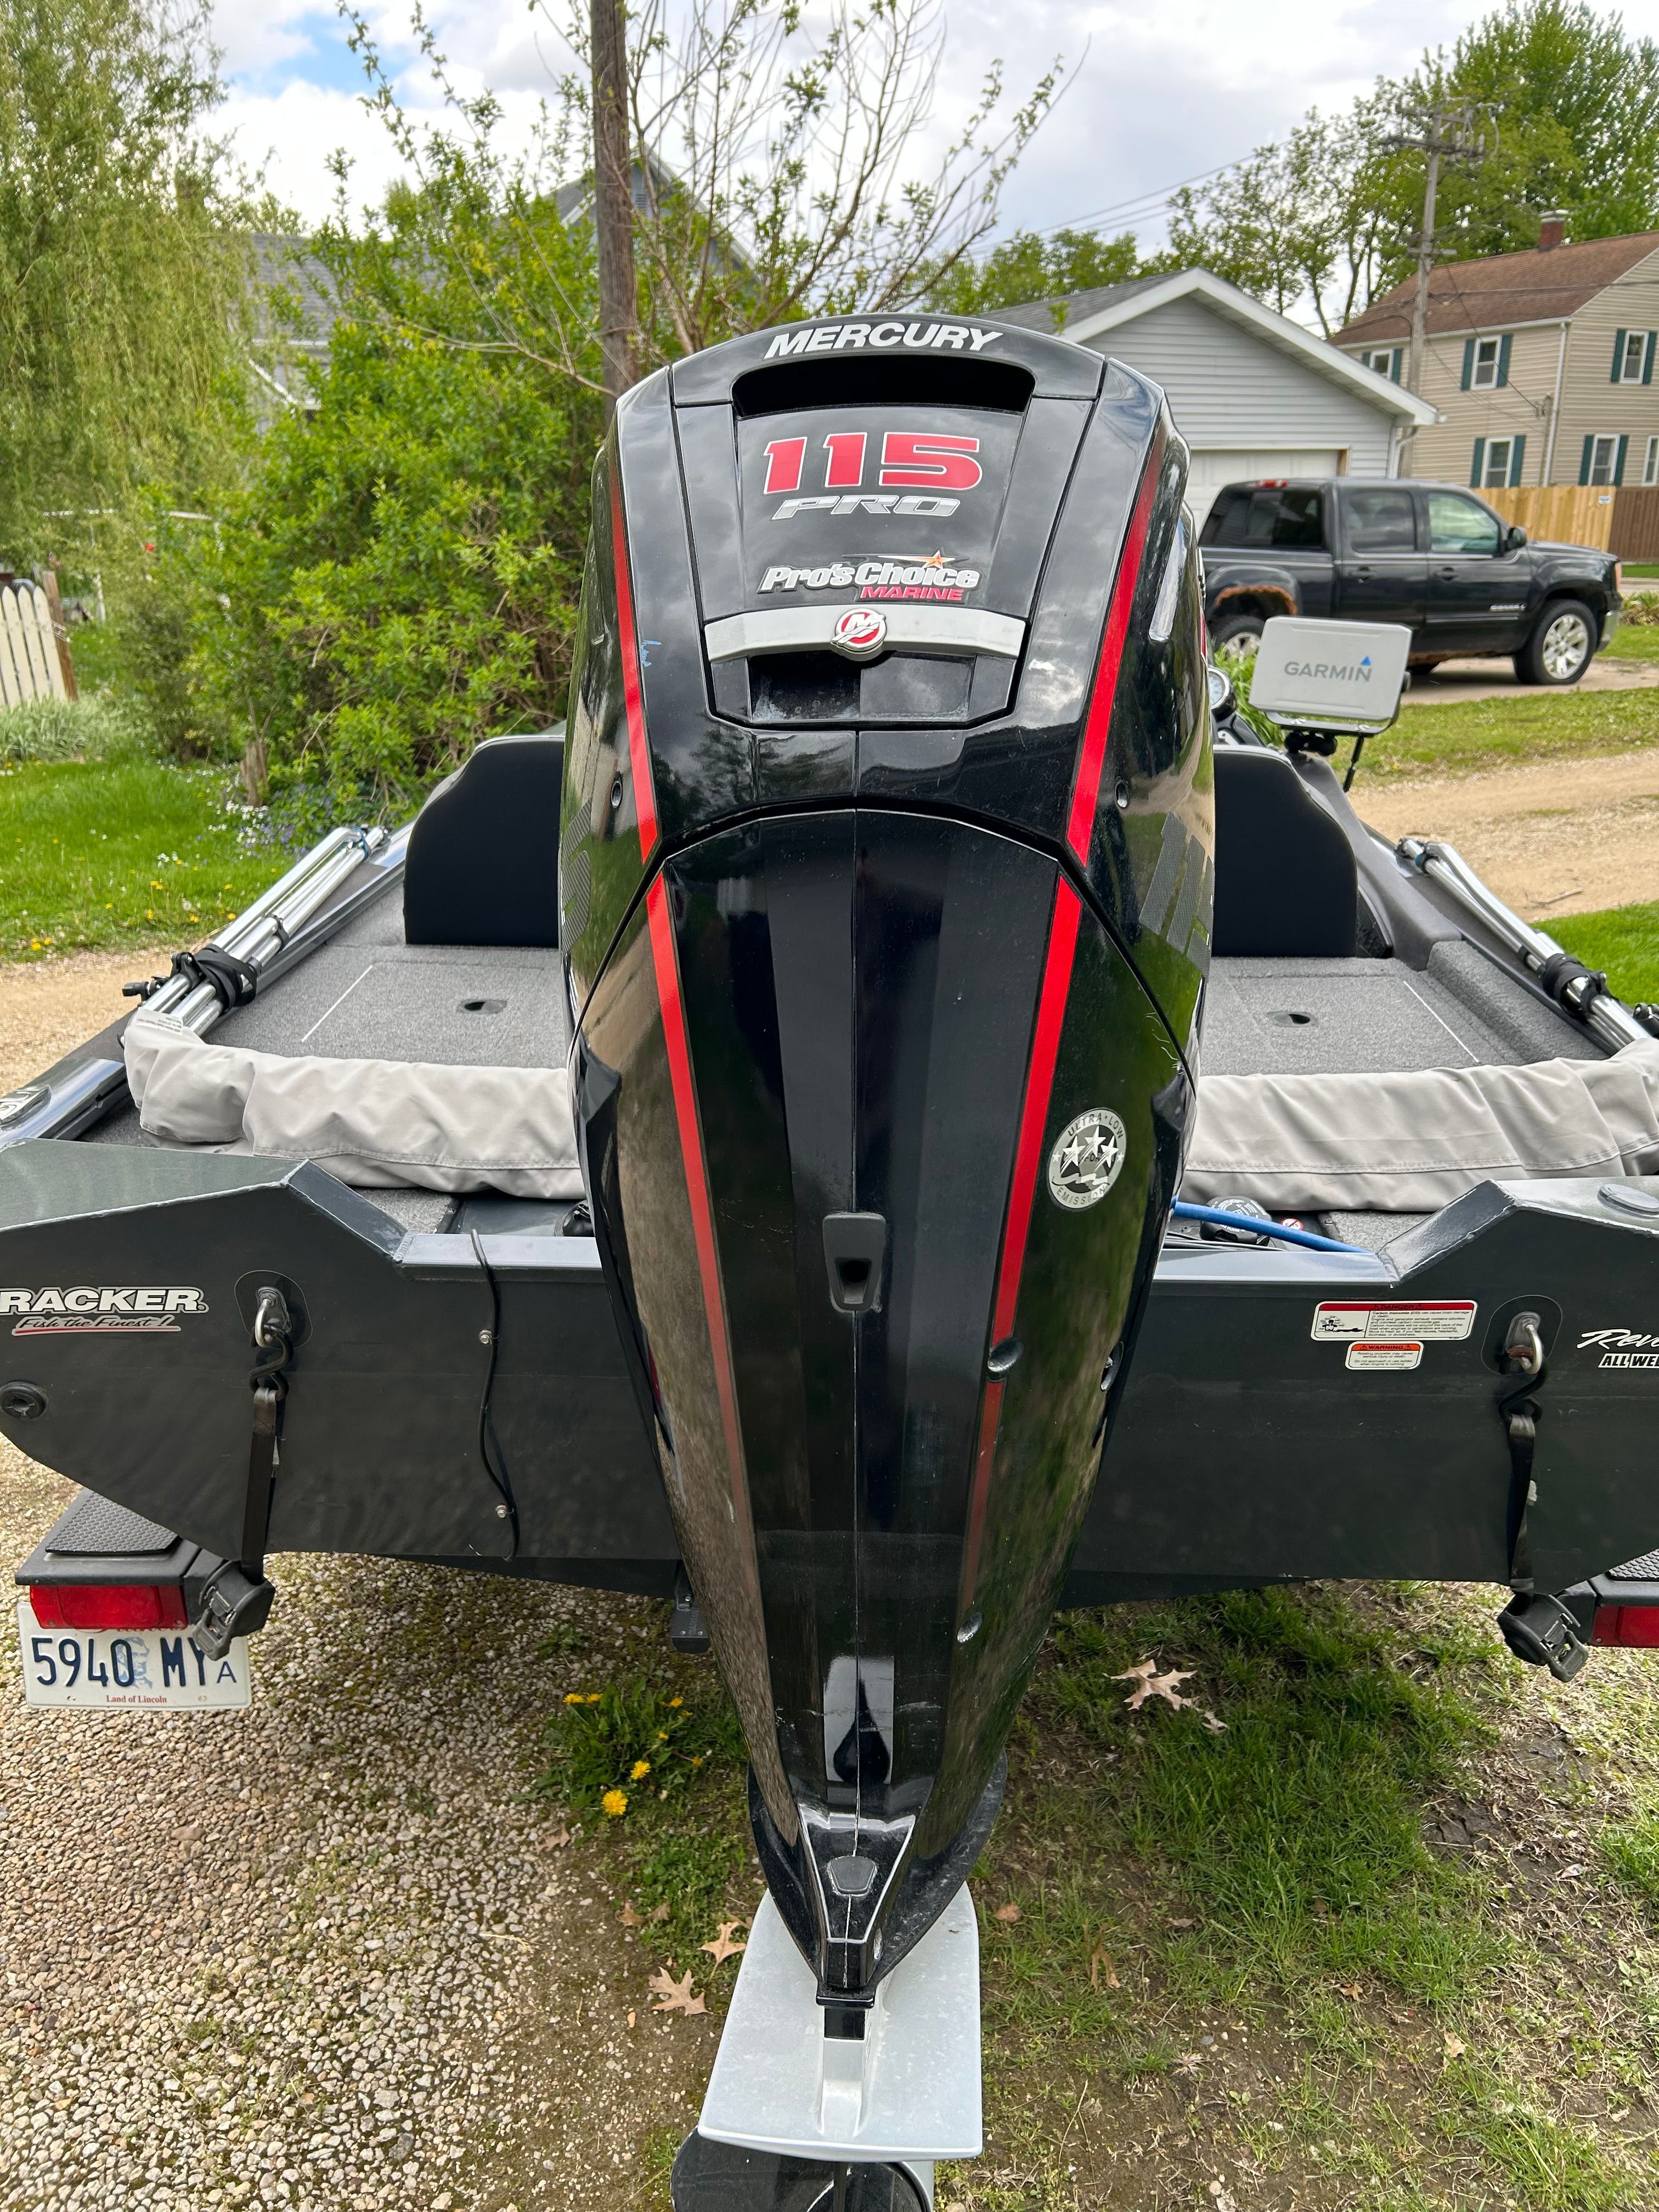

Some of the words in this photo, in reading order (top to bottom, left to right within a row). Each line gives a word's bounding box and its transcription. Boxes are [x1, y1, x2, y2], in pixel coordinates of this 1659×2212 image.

[764, 323, 1003, 359] MERCURY
[763, 432, 982, 494] 115
[771, 495, 961, 521] PRO
[760, 564, 855, 591] Pro's
[855, 562, 980, 588] Choice
[860, 586, 964, 601] MARINE
[1284, 662, 1372, 682] GARMIN
[19, 1317, 60, 1328] Fish
[63, 1316, 92, 1327] the
[95, 1317, 153, 1327] Finest
[1601, 1356, 1628, 1366] ALL
[31, 1638, 135, 1688] 5940
[160, 1637, 206, 1686] MY
[217, 1661, 237, 1683] A
[138, 1695, 167, 1703] Lincoln
